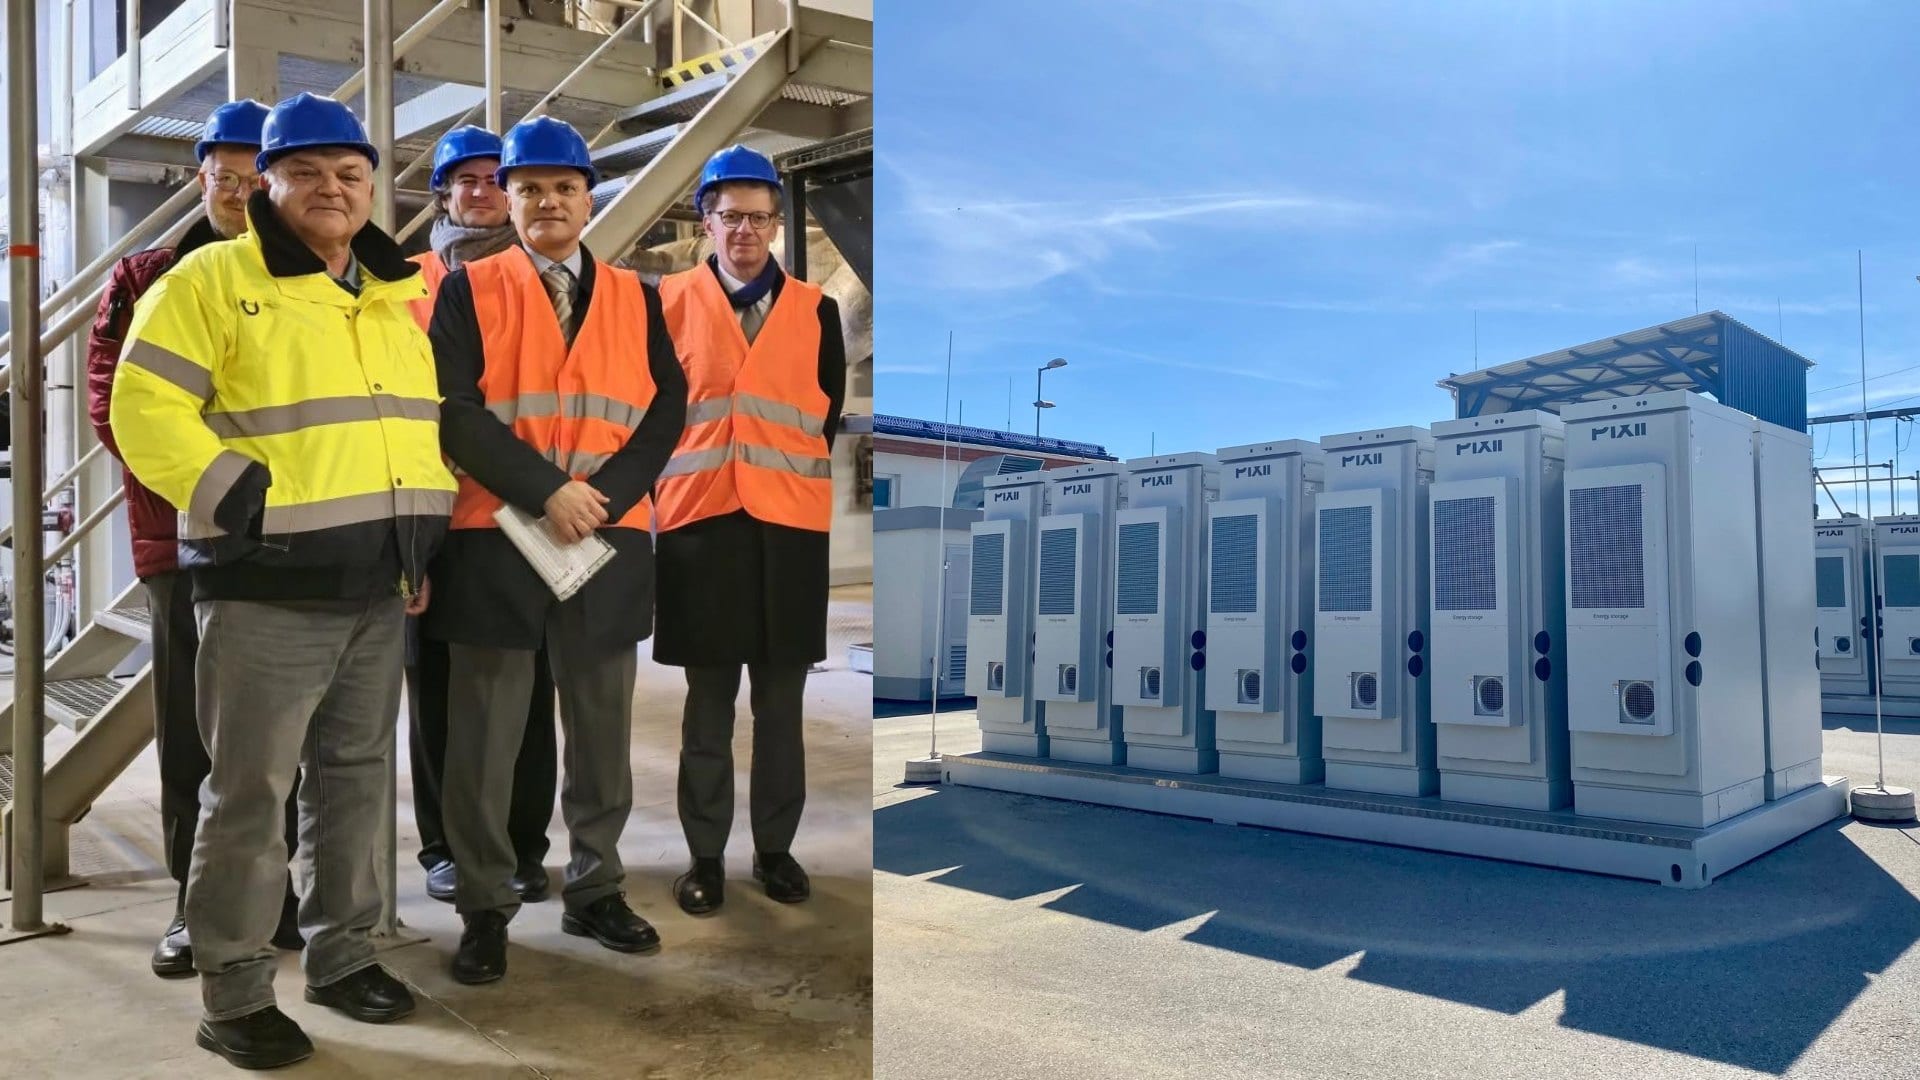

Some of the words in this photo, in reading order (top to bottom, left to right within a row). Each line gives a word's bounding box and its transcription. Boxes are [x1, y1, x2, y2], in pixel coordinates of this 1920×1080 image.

[1591, 422, 1646, 441] PIXII
[1456, 439, 1503, 456] PIXII
[1342, 452, 1382, 468] PIXII
